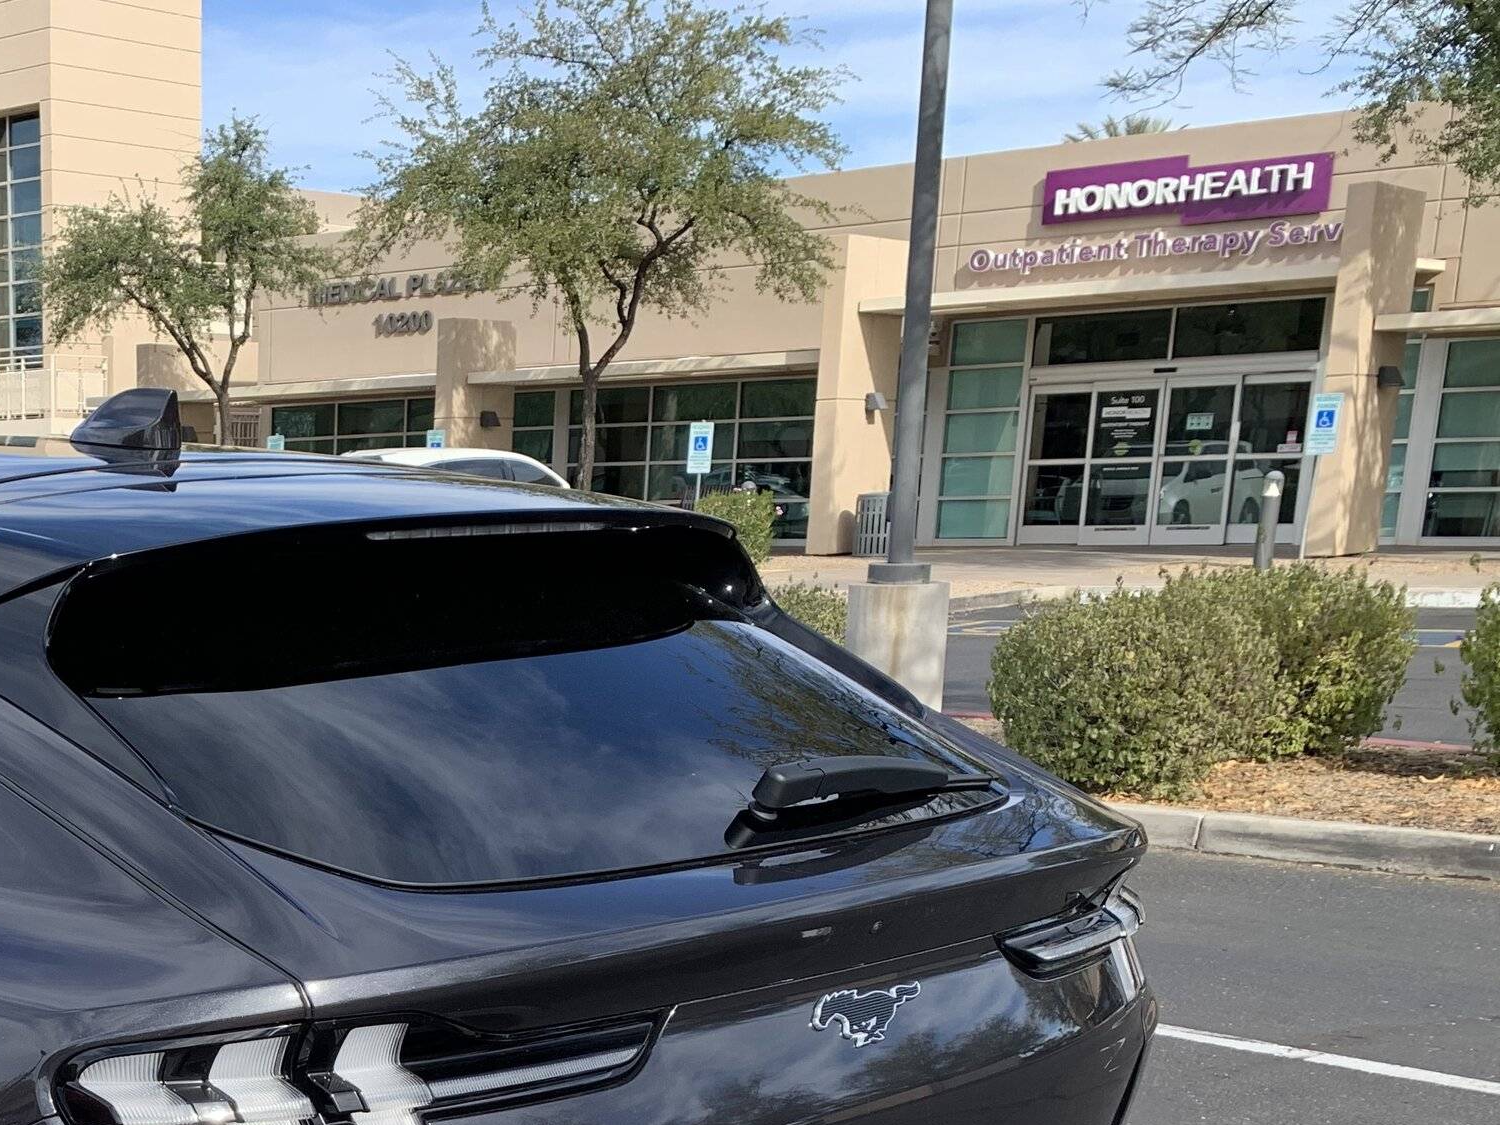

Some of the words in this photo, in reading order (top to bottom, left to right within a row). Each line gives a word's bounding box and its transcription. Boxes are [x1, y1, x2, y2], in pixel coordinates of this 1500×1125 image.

[1053, 161, 1314, 216] HONORHEALTH
[969, 238, 1129, 274] Outpatient
[1134, 229, 1260, 258] Therapy
[406, 267, 482, 297] PLAZ
[372, 310, 433, 338] 10200
[1111, 396, 1129, 404] Suite
[1131, 395, 1145, 404] 100
